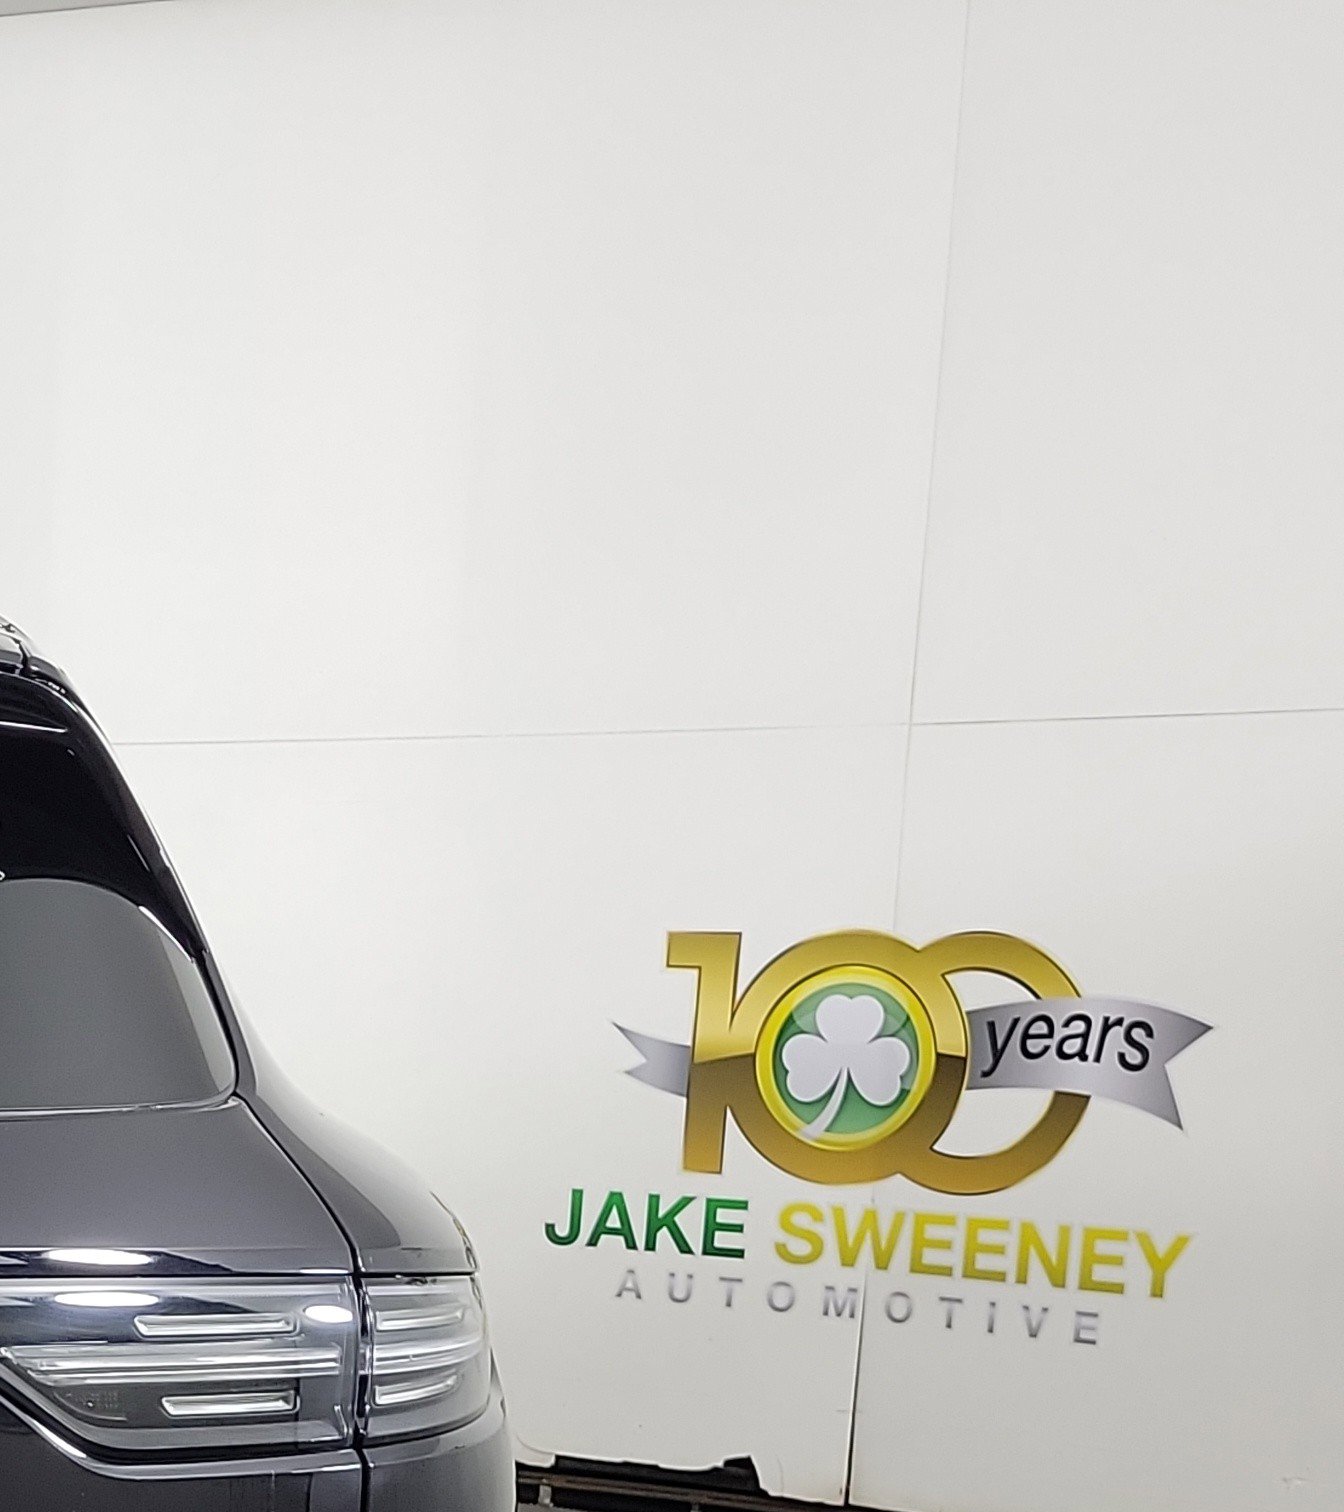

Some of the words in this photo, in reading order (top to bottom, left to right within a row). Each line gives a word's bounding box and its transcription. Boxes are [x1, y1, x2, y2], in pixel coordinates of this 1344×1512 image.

[665, 928, 1093, 1196] 100
[980, 1010, 1157, 1078] years
[544, 1187, 750, 1259] JAKE
[774, 1202, 1192, 1298] SWEENEY
[615, 1268, 1100, 1345] AUTOMOTIVE
